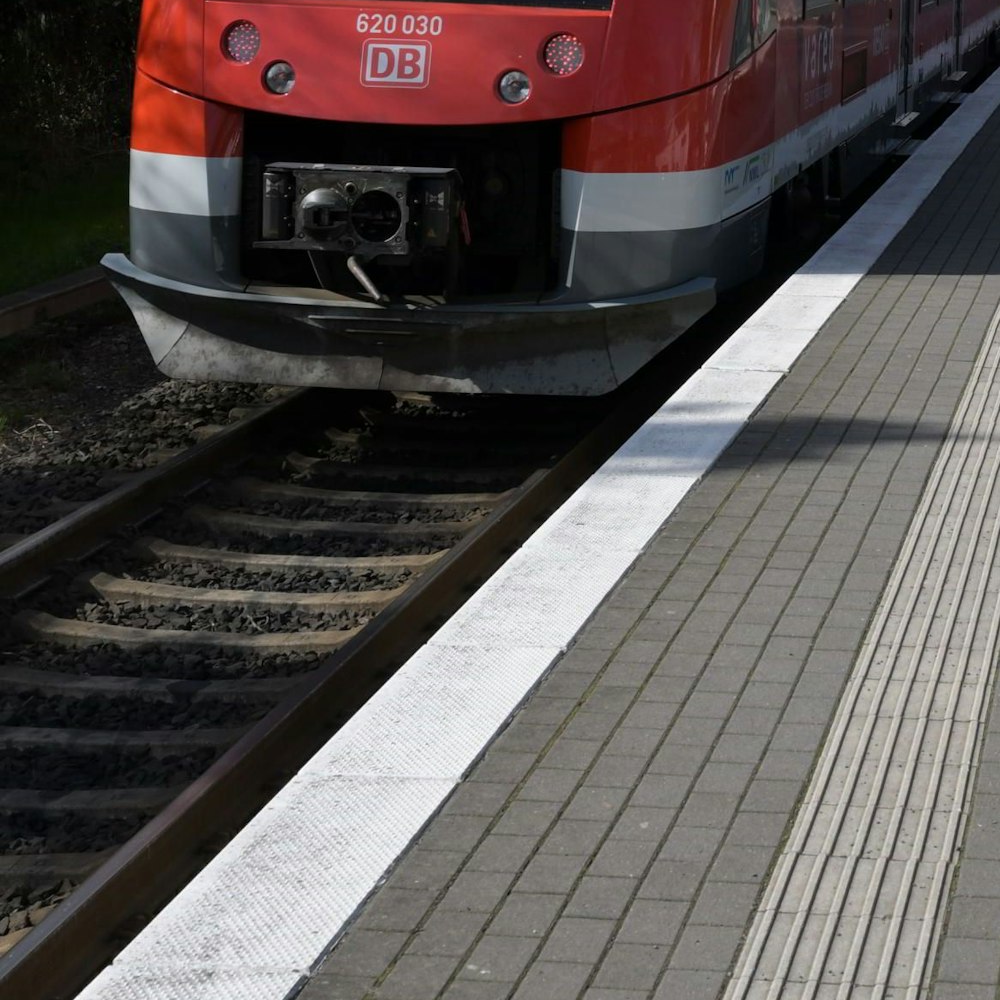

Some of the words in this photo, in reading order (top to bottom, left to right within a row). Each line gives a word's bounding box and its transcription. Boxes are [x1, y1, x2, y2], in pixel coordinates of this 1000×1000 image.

[356, 12, 397, 34] 620
[401, 14, 443, 36] 030
[368, 45, 423, 81] DB
